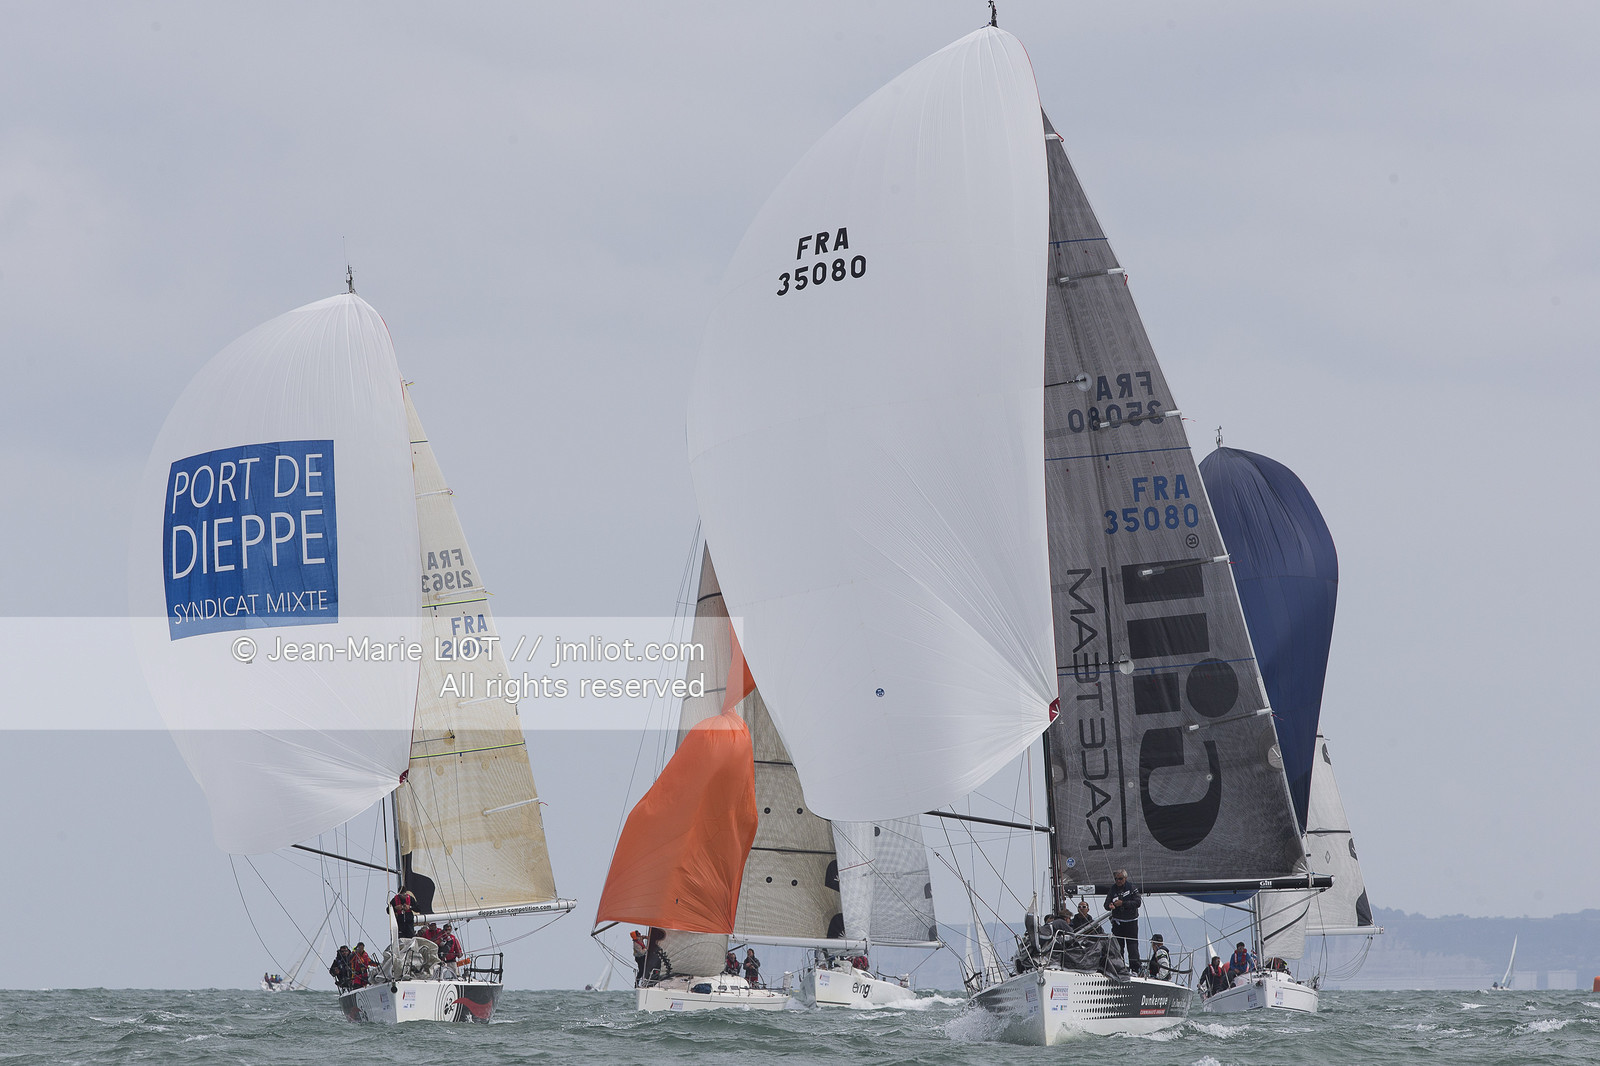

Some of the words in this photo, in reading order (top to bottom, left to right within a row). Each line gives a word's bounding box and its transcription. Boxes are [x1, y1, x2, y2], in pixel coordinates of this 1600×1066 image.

[797, 227, 849, 260] FRA
[776, 255, 867, 296] 35080
[172, 457, 260, 514] PORT
[274, 453, 323, 498] DE
[1132, 474, 1190, 502] FRA
[1104, 503, 1199, 535] 35080
[172, 509, 326, 580] DIEPPE
[173, 594, 259, 625] SYNDICAT
[266, 590, 328, 613] MIXTE
[451, 614, 488, 636] FRA
[1141, 994, 1168, 1008] Dunkerque
